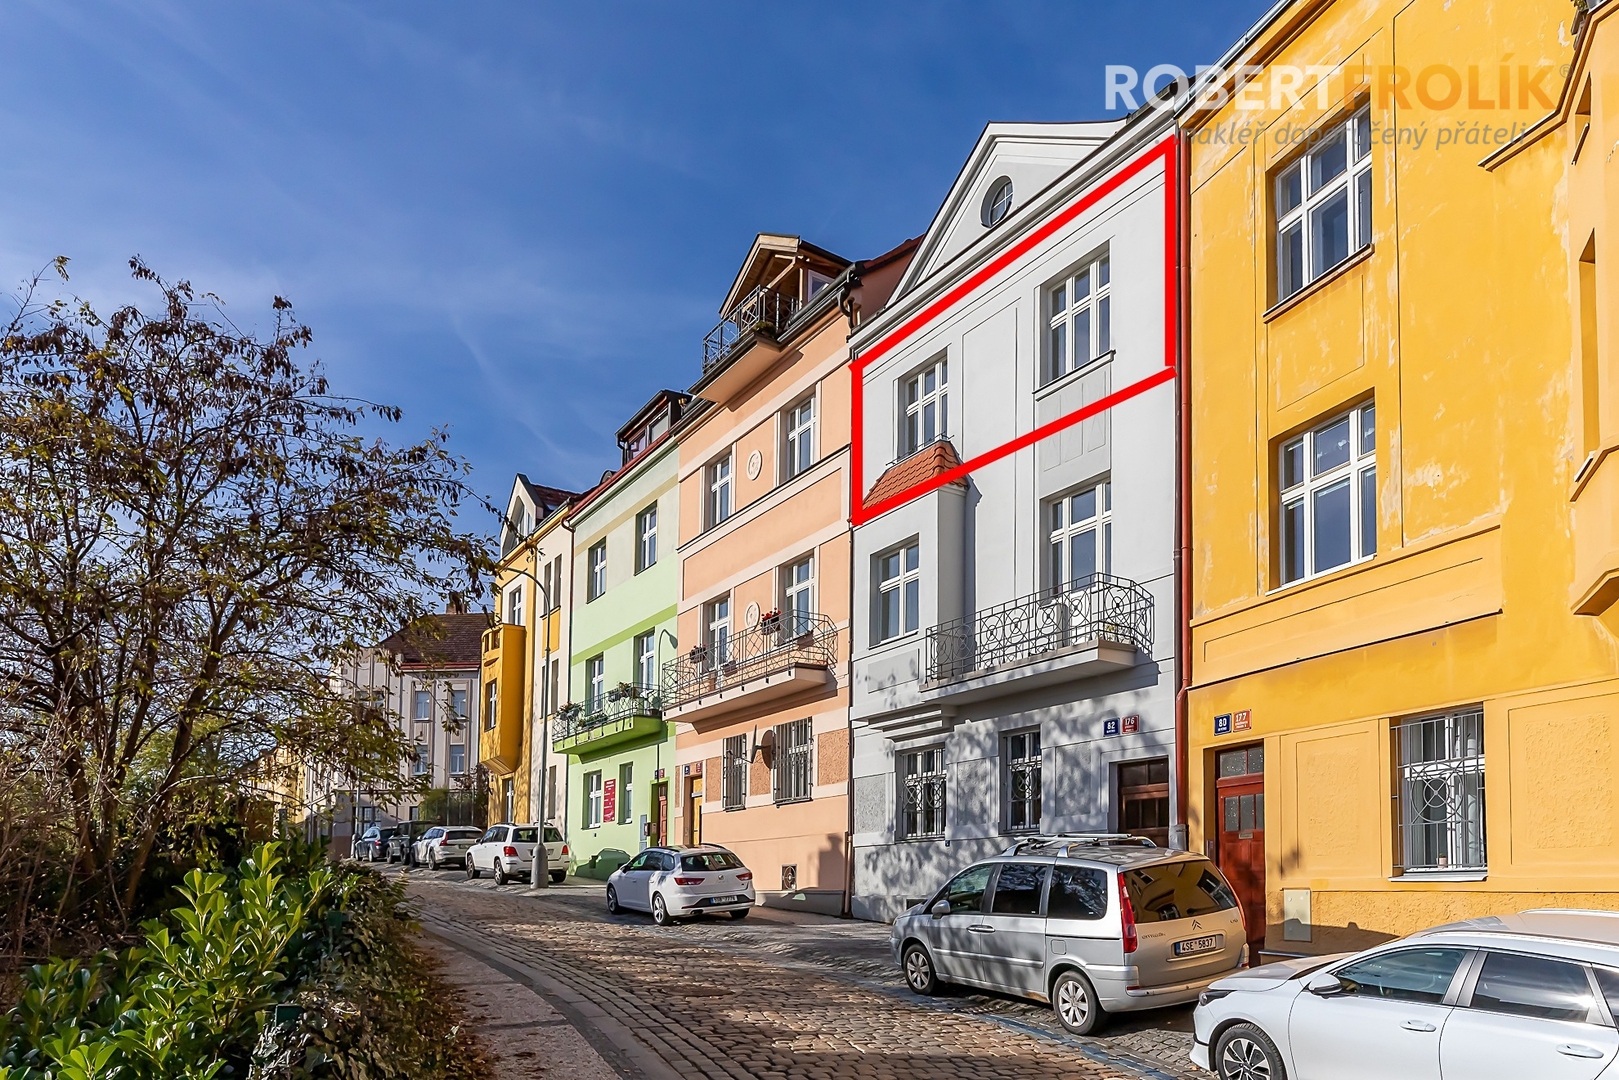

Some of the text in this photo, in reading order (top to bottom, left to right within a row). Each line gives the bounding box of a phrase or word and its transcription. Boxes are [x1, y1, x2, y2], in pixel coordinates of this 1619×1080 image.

[1125, 717, 1135, 725] 176
[1235, 712, 1247, 722] 177
[1218, 718, 1227, 727] 80
[1181, 938, 1213, 951] 4SE 5837
